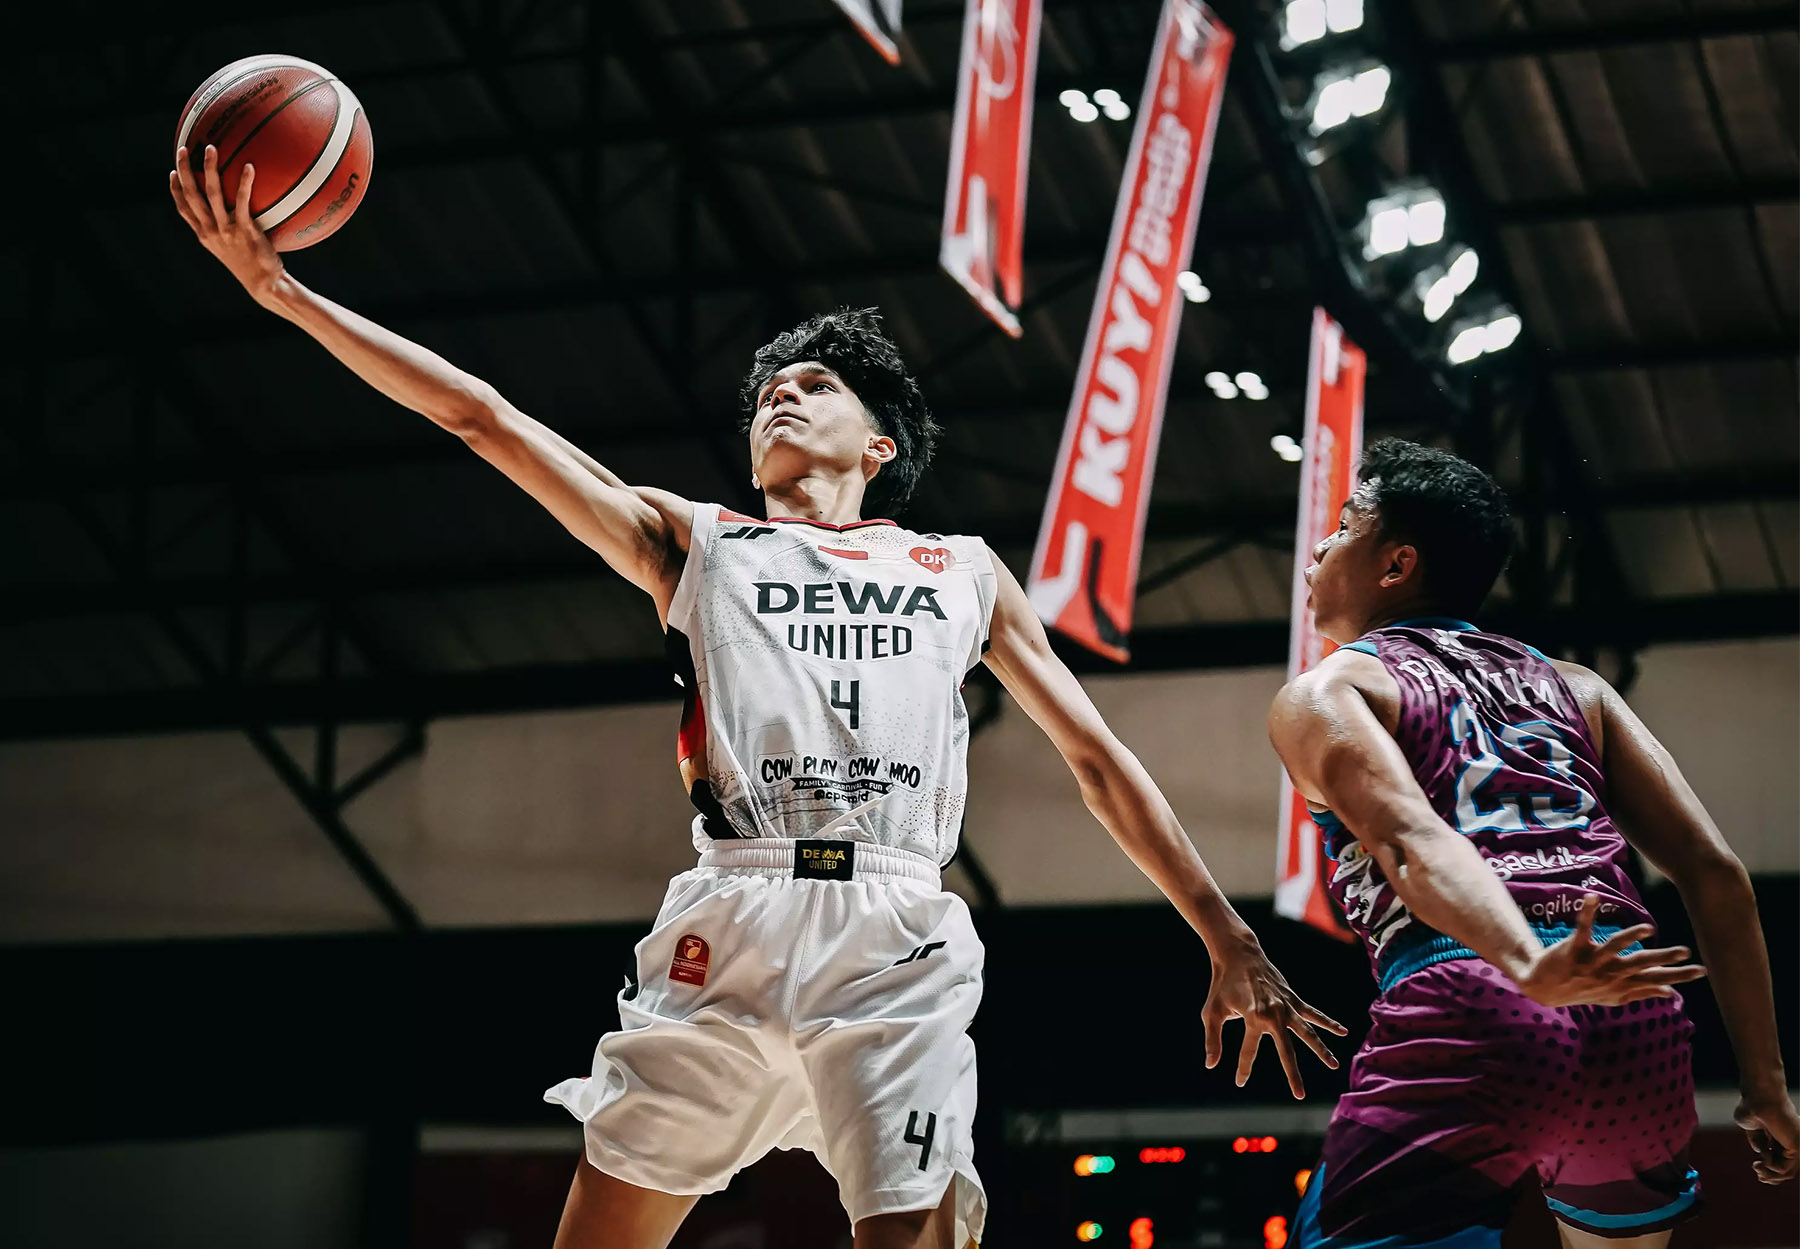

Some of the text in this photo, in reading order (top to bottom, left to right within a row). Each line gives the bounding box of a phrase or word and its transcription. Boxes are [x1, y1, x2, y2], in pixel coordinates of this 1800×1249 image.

[920, 553, 947, 565] DK
[752, 582, 949, 620] DEWA
[788, 624, 912, 660] UNITED
[831, 680, 859, 729] 4
[761, 756, 921, 789] COW PLAY COW MOO
[1450, 698, 1597, 833] 23
[800, 780, 826, 788] FAMILY
[869, 782, 883, 791] FUN
[809, 860, 838, 870] UNITED
[904, 1110, 937, 1171] 4
